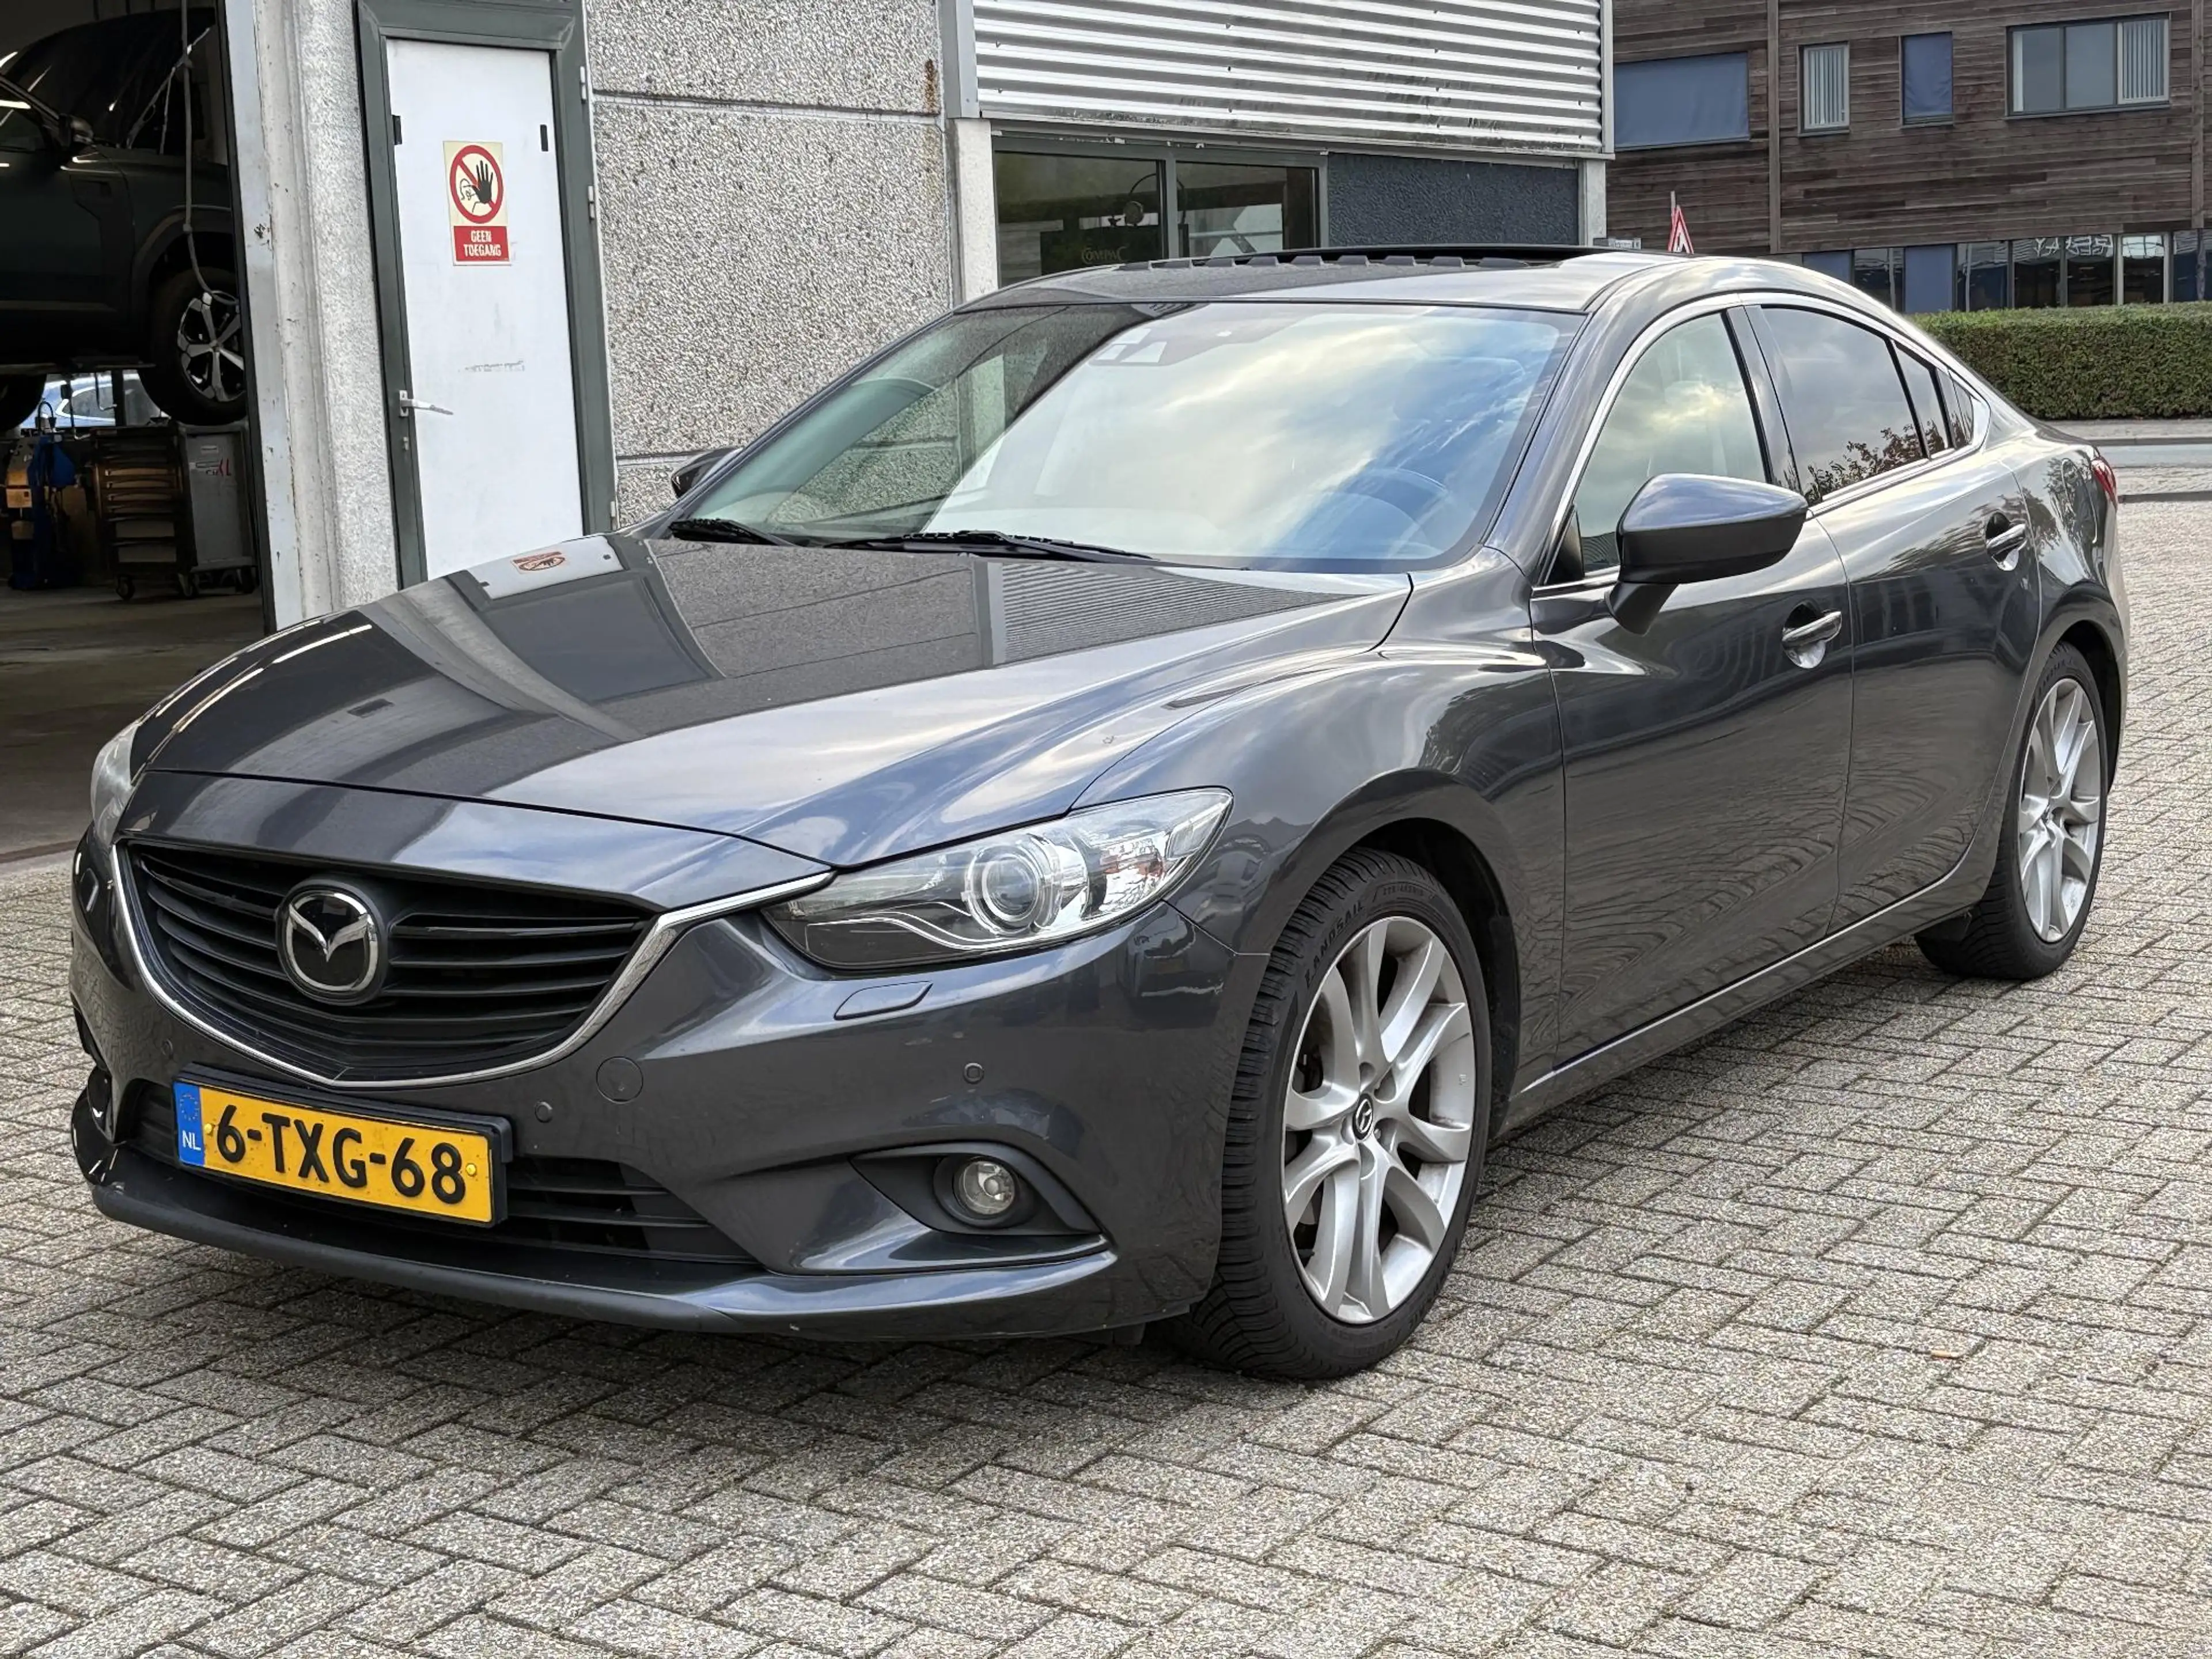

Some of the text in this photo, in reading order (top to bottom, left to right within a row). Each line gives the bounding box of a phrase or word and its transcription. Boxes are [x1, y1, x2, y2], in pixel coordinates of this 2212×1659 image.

[471, 230, 492, 243] GEEN
[463, 244, 502, 257] TOEGANG
[181, 1129, 202, 1151] NL
[216, 1104, 466, 1205] 6-TXG-68
